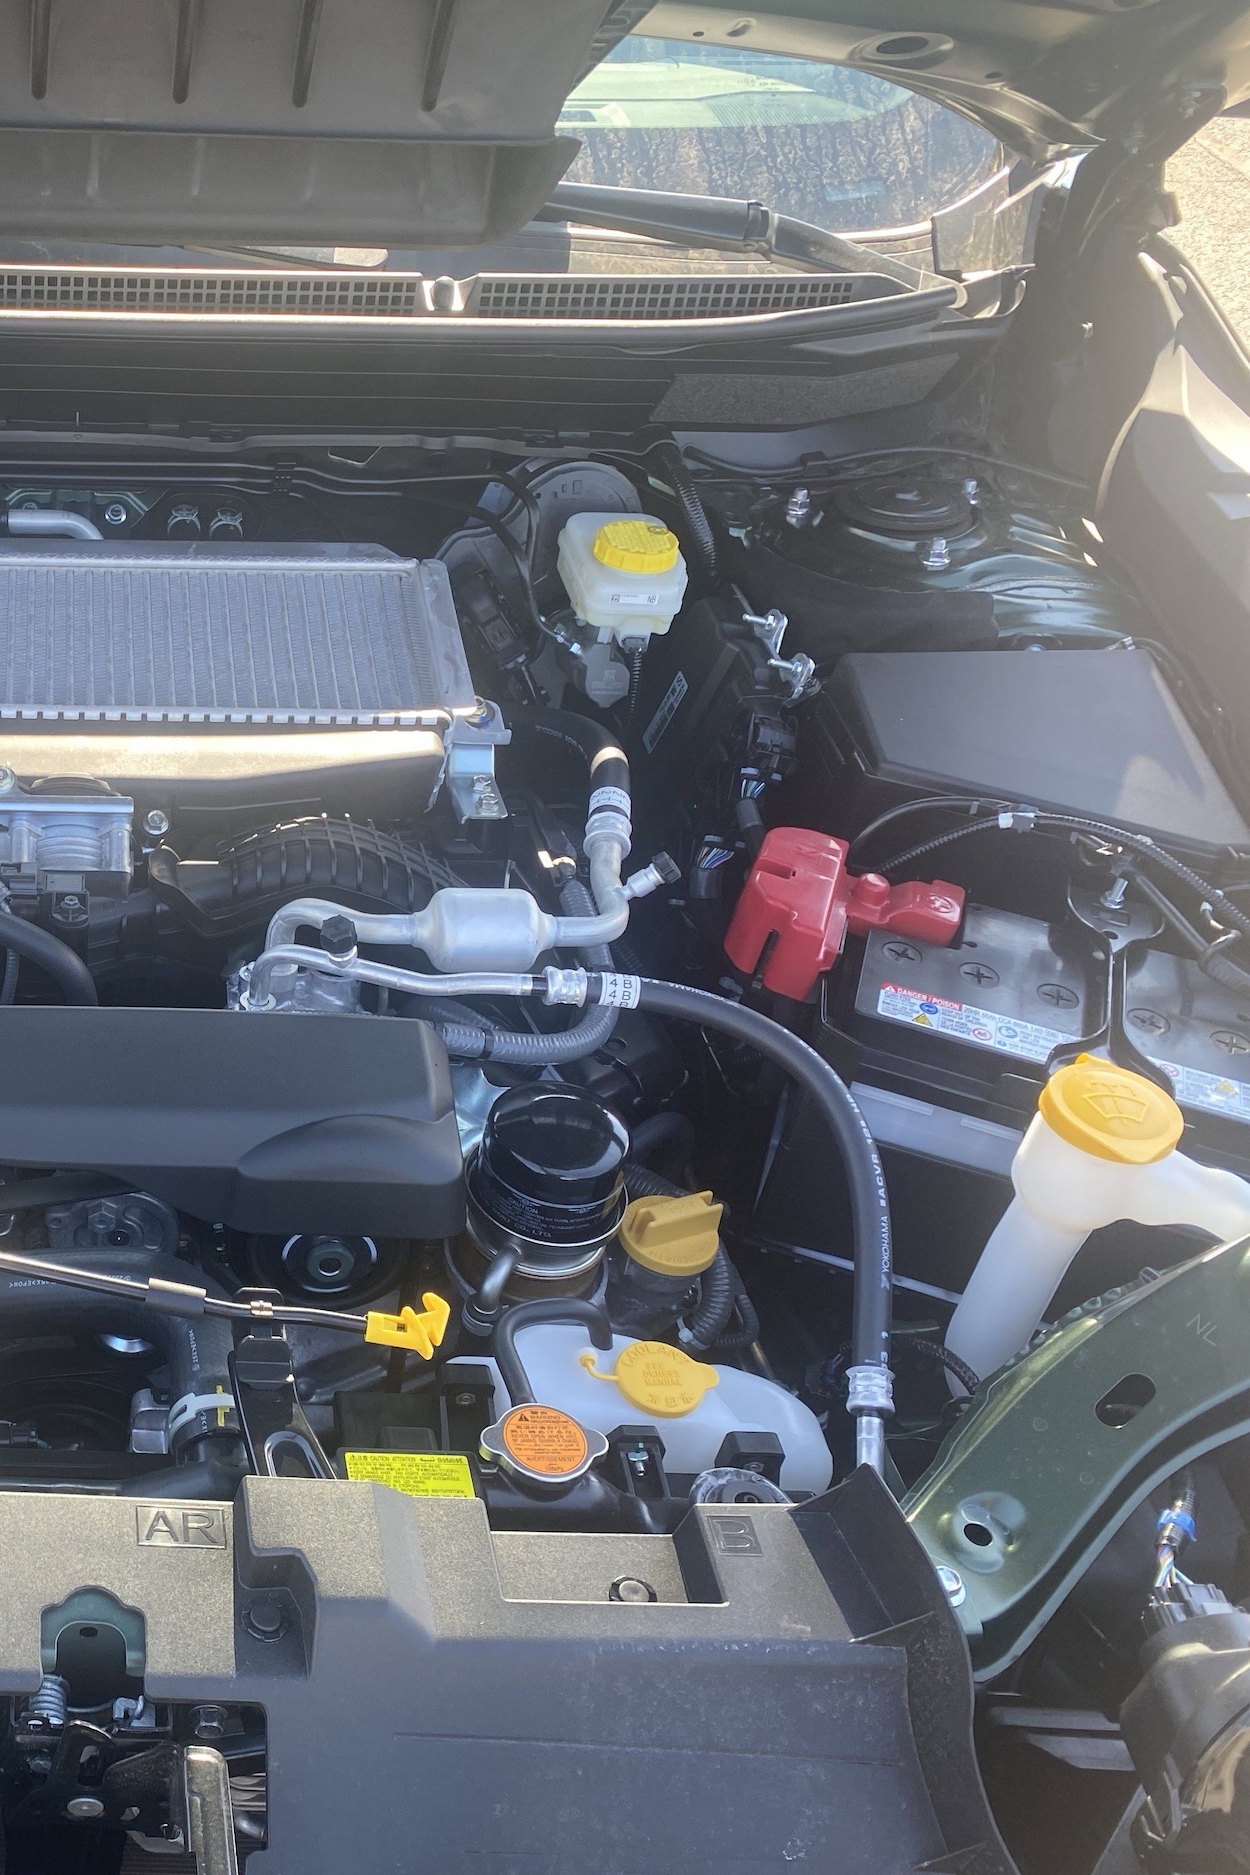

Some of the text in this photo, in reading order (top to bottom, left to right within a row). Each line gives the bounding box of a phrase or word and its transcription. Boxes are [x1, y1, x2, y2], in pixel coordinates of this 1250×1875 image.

[896, 987, 927, 1001] DANGER
[931, 997, 959, 1010] POISON
[508, 1196, 538, 1214] CAUTION
[880, 1216, 890, 1273] YOKOHAMA
[1185, 1313, 1217, 1346] NL
[621, 1344, 692, 1367] COOLANT
[145, 1510, 218, 1543] AR
[712, 1520, 756, 1551] B
